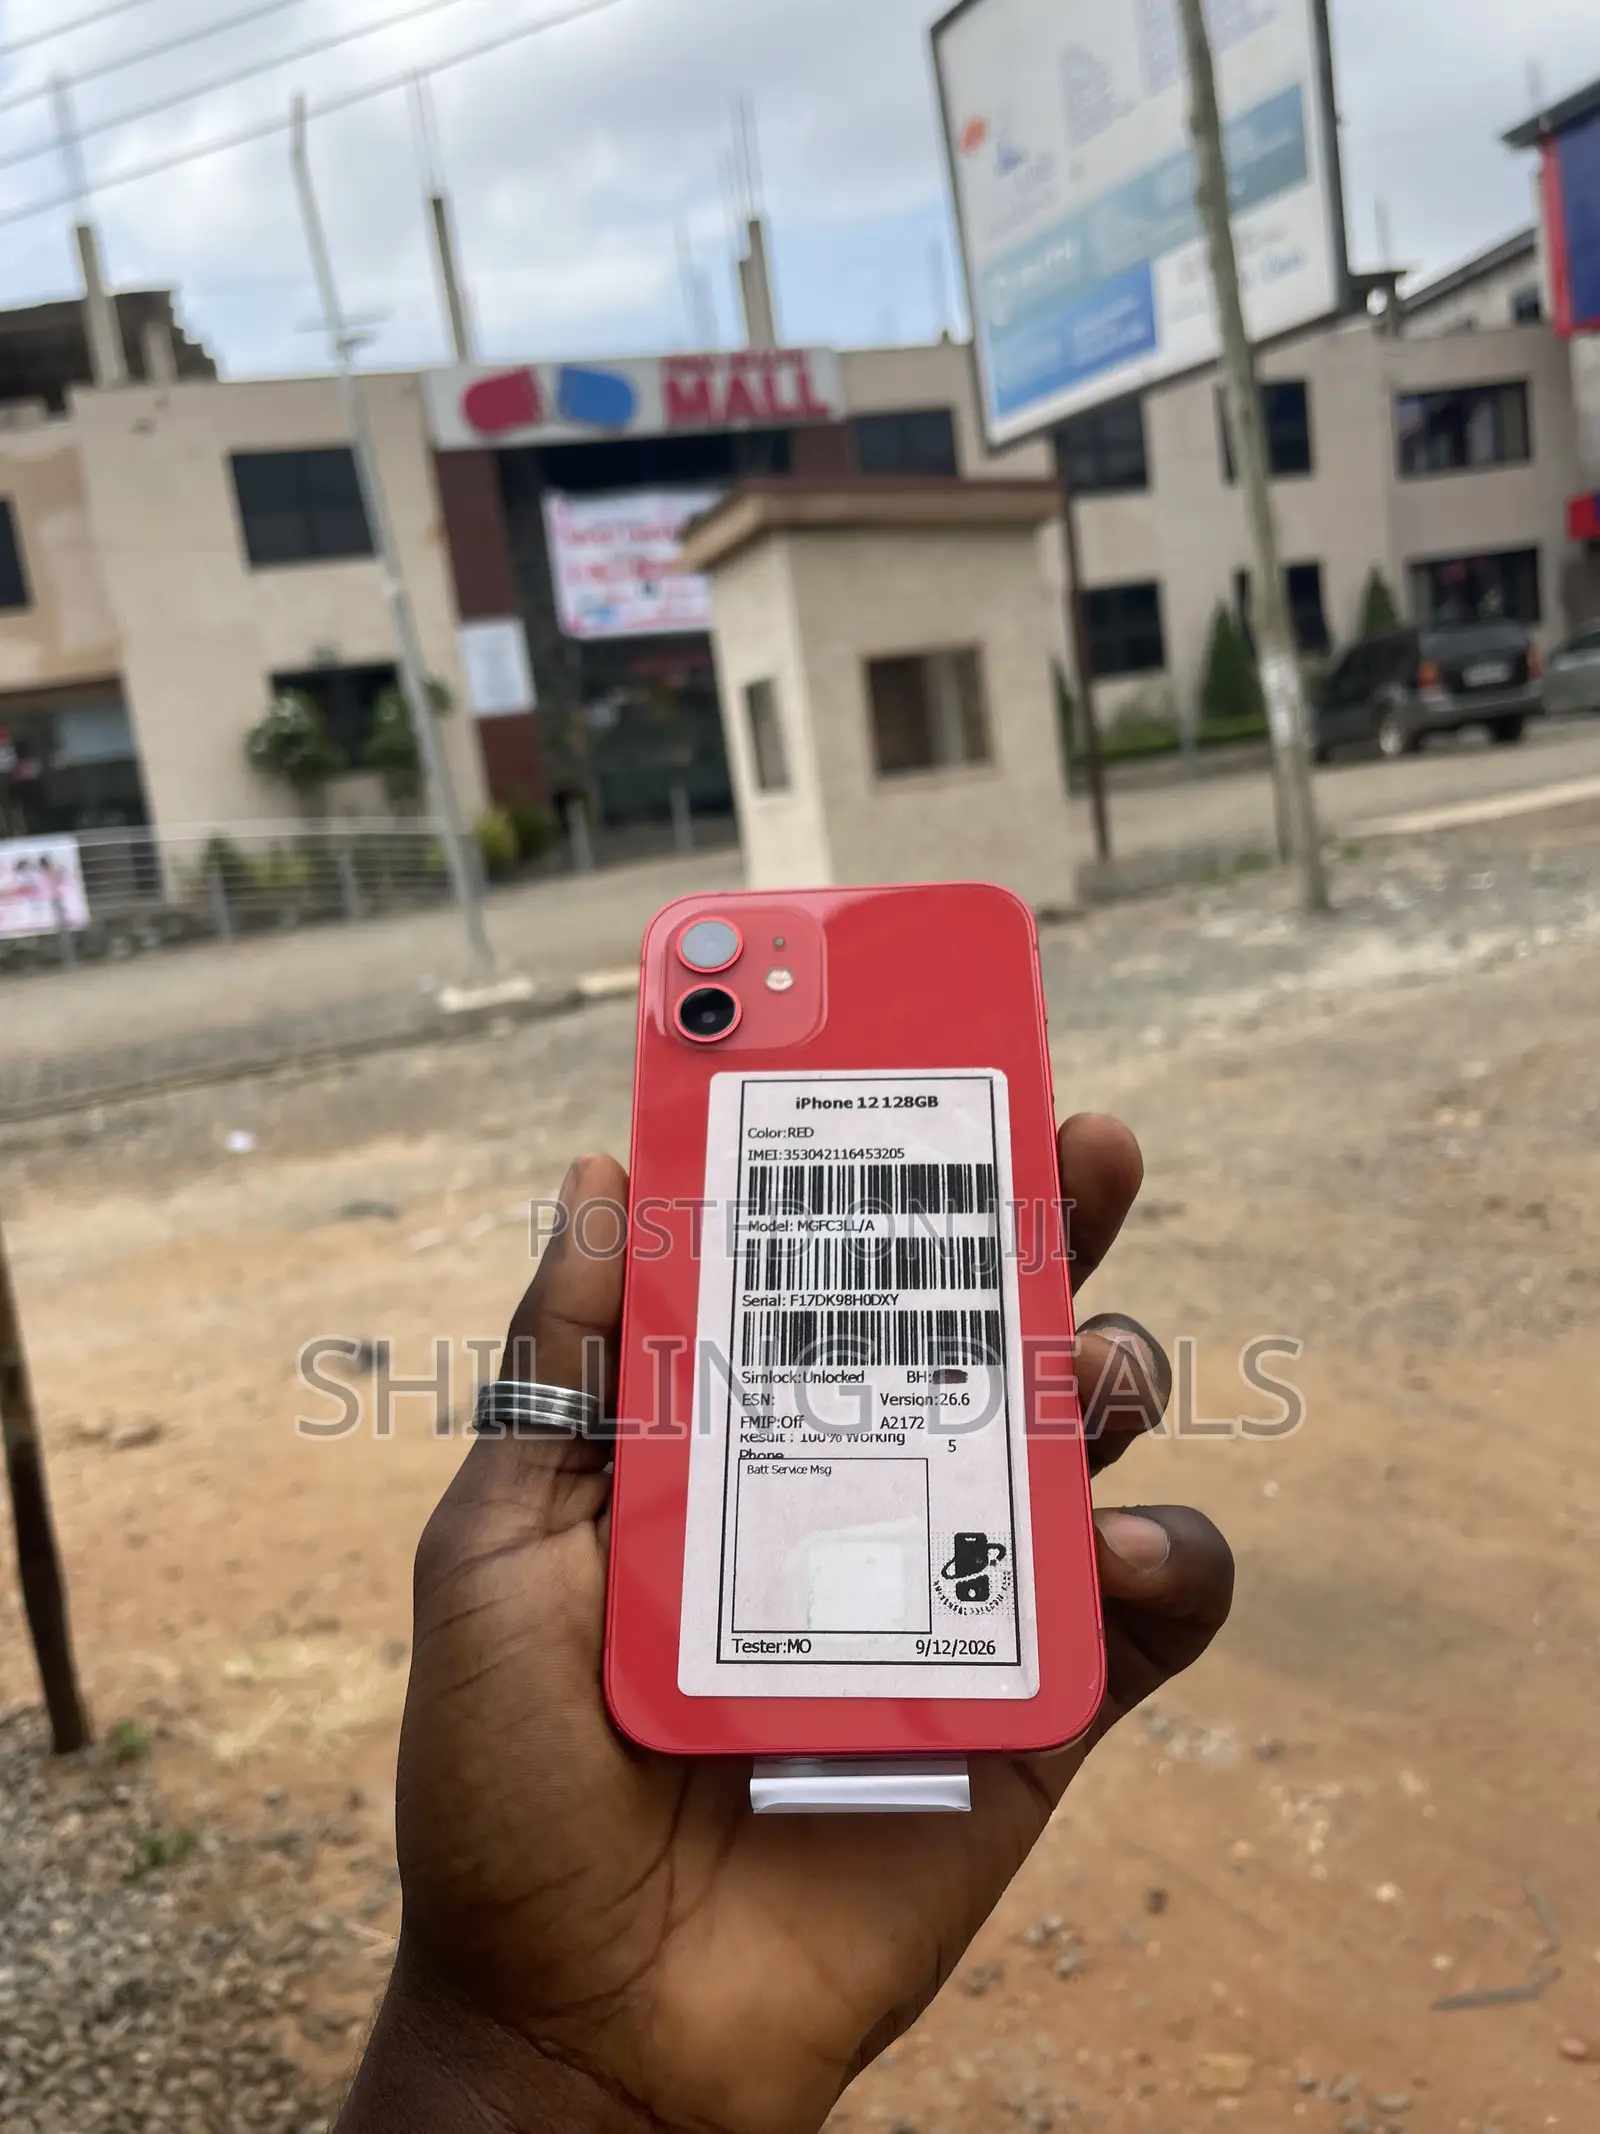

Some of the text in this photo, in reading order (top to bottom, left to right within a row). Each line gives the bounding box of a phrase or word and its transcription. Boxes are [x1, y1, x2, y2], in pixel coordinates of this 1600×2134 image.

[796, 1096, 939, 1109] iPhone 12 128GB
[748, 1127, 815, 1139] Color:RED
[748, 1148, 905, 1161] IMEI:353042116453205
[748, 1220, 875, 1233] Model: MGFC3LL/A
[742, 1294, 786, 1307] Serial:
[741, 1370, 865, 1384] Simlock:Unlocked
[742, 1394, 775, 1406] ESN:
[880, 1393, 970, 1407] Version:26.6
[740, 1415, 805, 1429] FMIP:Off
[880, 1416, 925, 1430] A2172
[947, 1439, 957, 1453] 5
[747, 1465, 832, 1477] Batt Service Msg
[731, 1639, 812, 1654] Tester:MO
[915, 1639, 996, 1657] 9/12/2026
